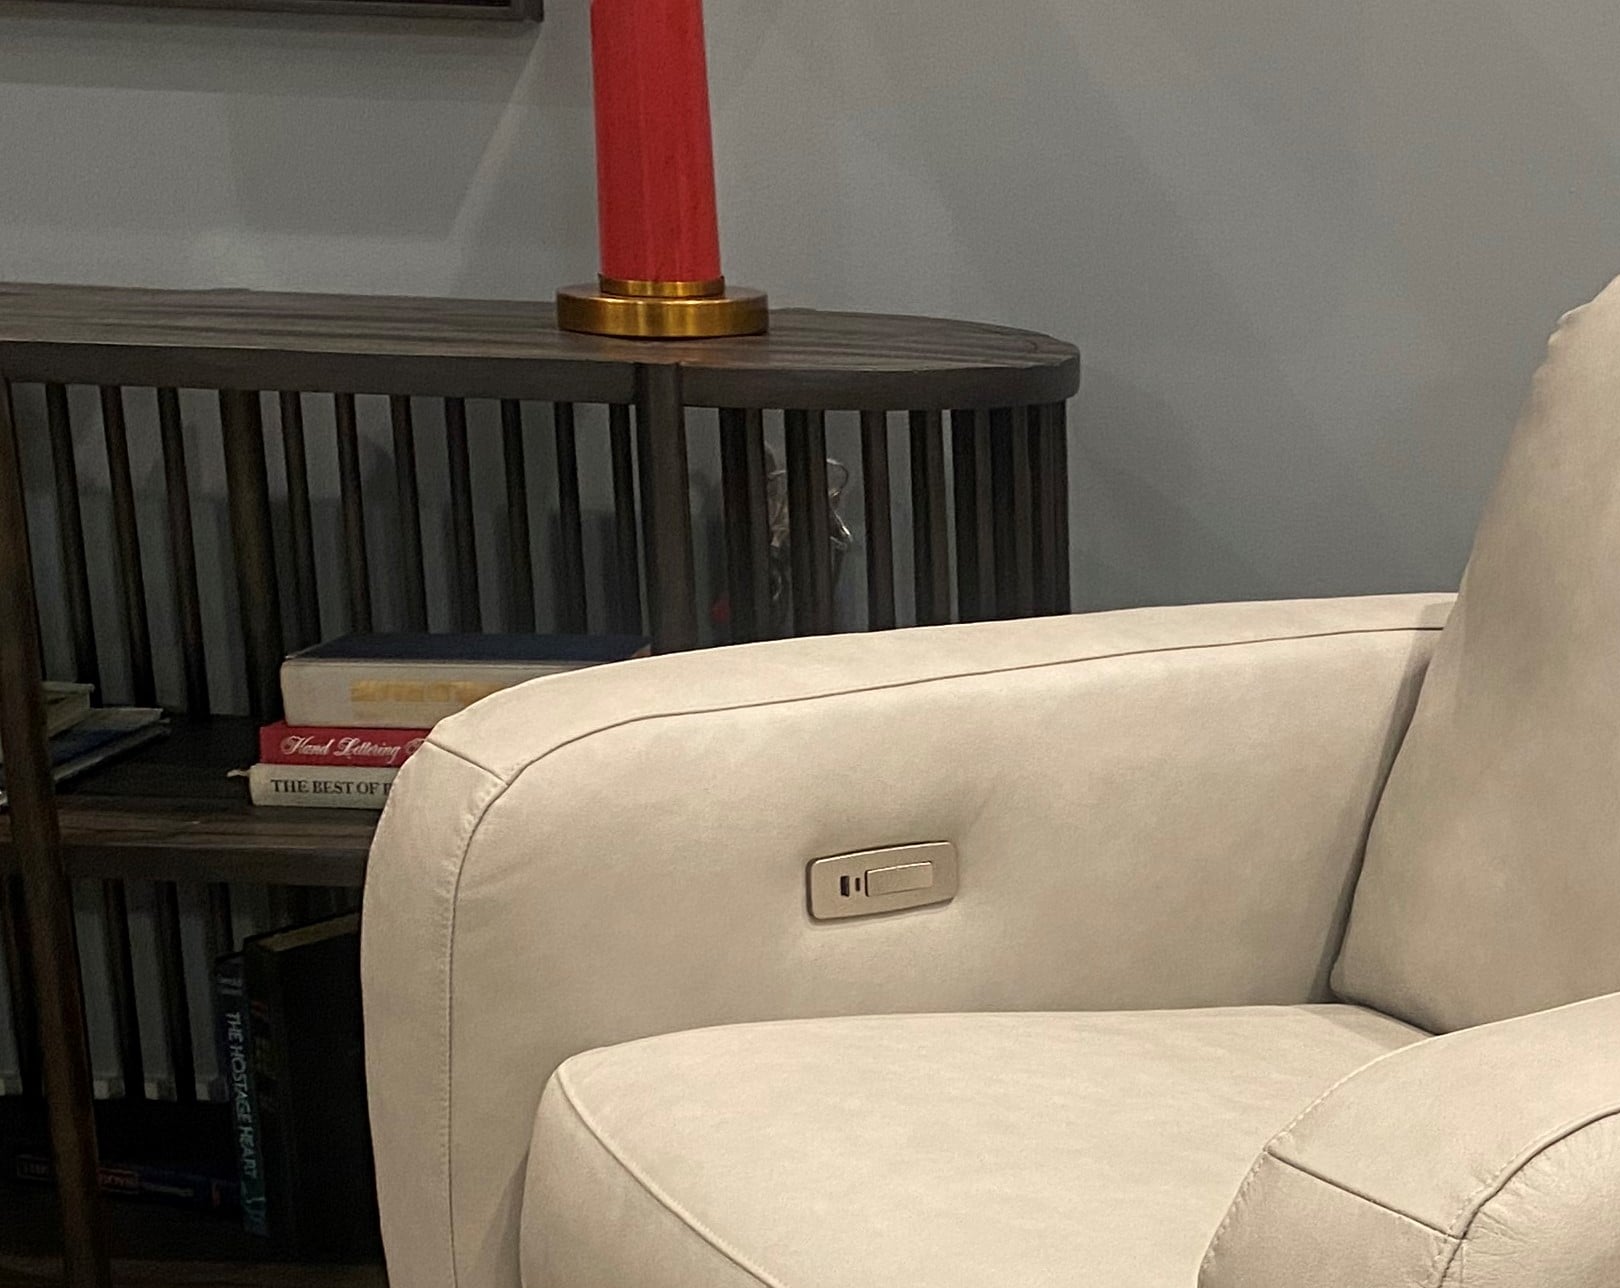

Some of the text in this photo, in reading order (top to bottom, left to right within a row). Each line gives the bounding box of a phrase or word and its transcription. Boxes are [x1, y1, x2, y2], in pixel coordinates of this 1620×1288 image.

[280, 736, 336, 756] Hand
[333, 737, 402, 764] Lettering
[271, 779, 311, 794] THE
[313, 780, 354, 795] BEST
[356, 781, 381, 795] OF
[225, 1011, 243, 1045] THE
[230, 1045, 253, 1125] HOSTAGE
[239, 1125, 258, 1179] HEART
